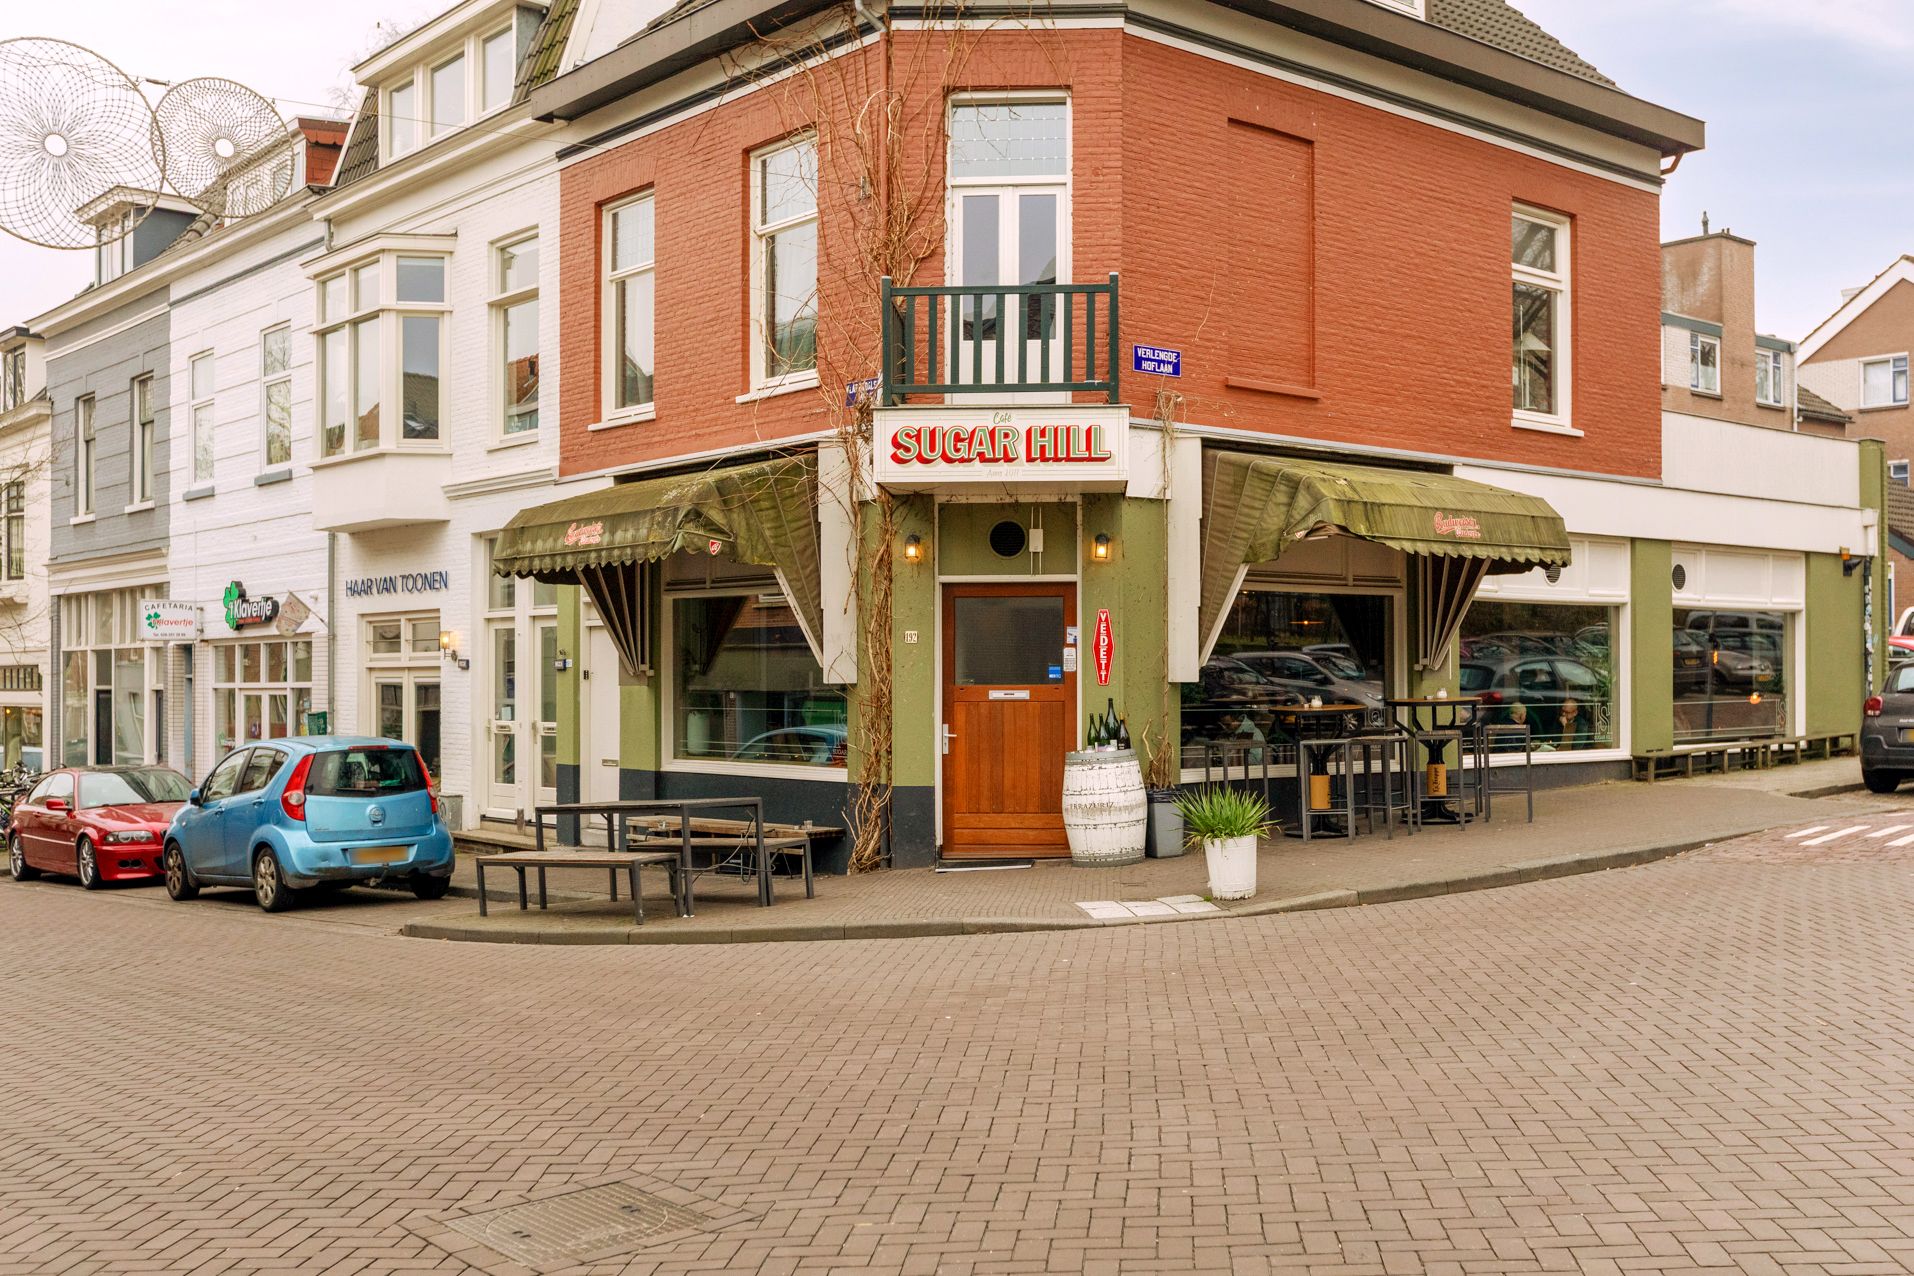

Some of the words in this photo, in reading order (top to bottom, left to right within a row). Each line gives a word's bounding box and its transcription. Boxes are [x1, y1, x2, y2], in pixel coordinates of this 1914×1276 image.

[1137, 347, 1178, 363] VERLENGDE
[1141, 360, 1173, 374] HOFLAAN
[890, 425, 1020, 464] SUGAR
[1025, 425, 1112, 463] HILL
[345, 578, 373, 597] HAAR
[374, 575, 397, 595] VAN
[399, 570, 448, 593] TOONEN
[144, 603, 193, 611] CAFETARIA
[234, 597, 272, 620] Klavertje
[1099, 612, 1109, 681] VEDETT
